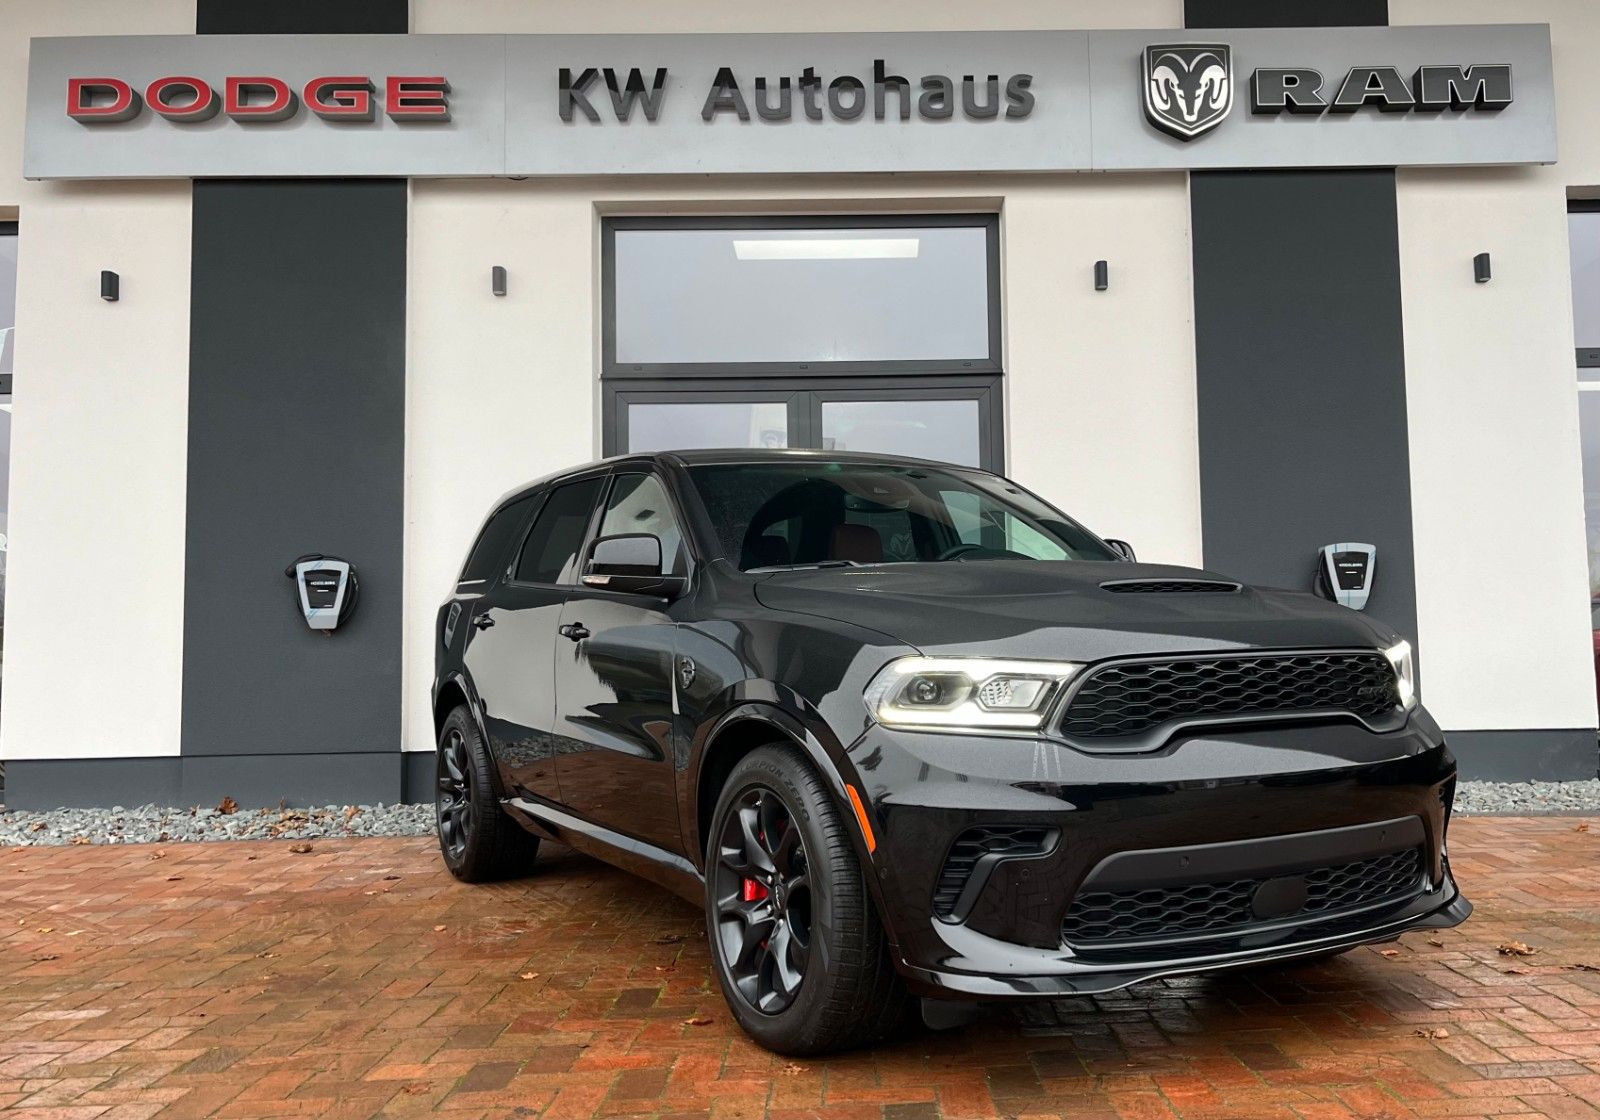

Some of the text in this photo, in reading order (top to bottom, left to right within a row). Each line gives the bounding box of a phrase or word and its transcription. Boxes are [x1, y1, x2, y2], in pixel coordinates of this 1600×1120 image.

[67, 76, 450, 122] DODGE
[558, 58, 1036, 122] KW Autohaus
[1250, 64, 1513, 114] RAM
